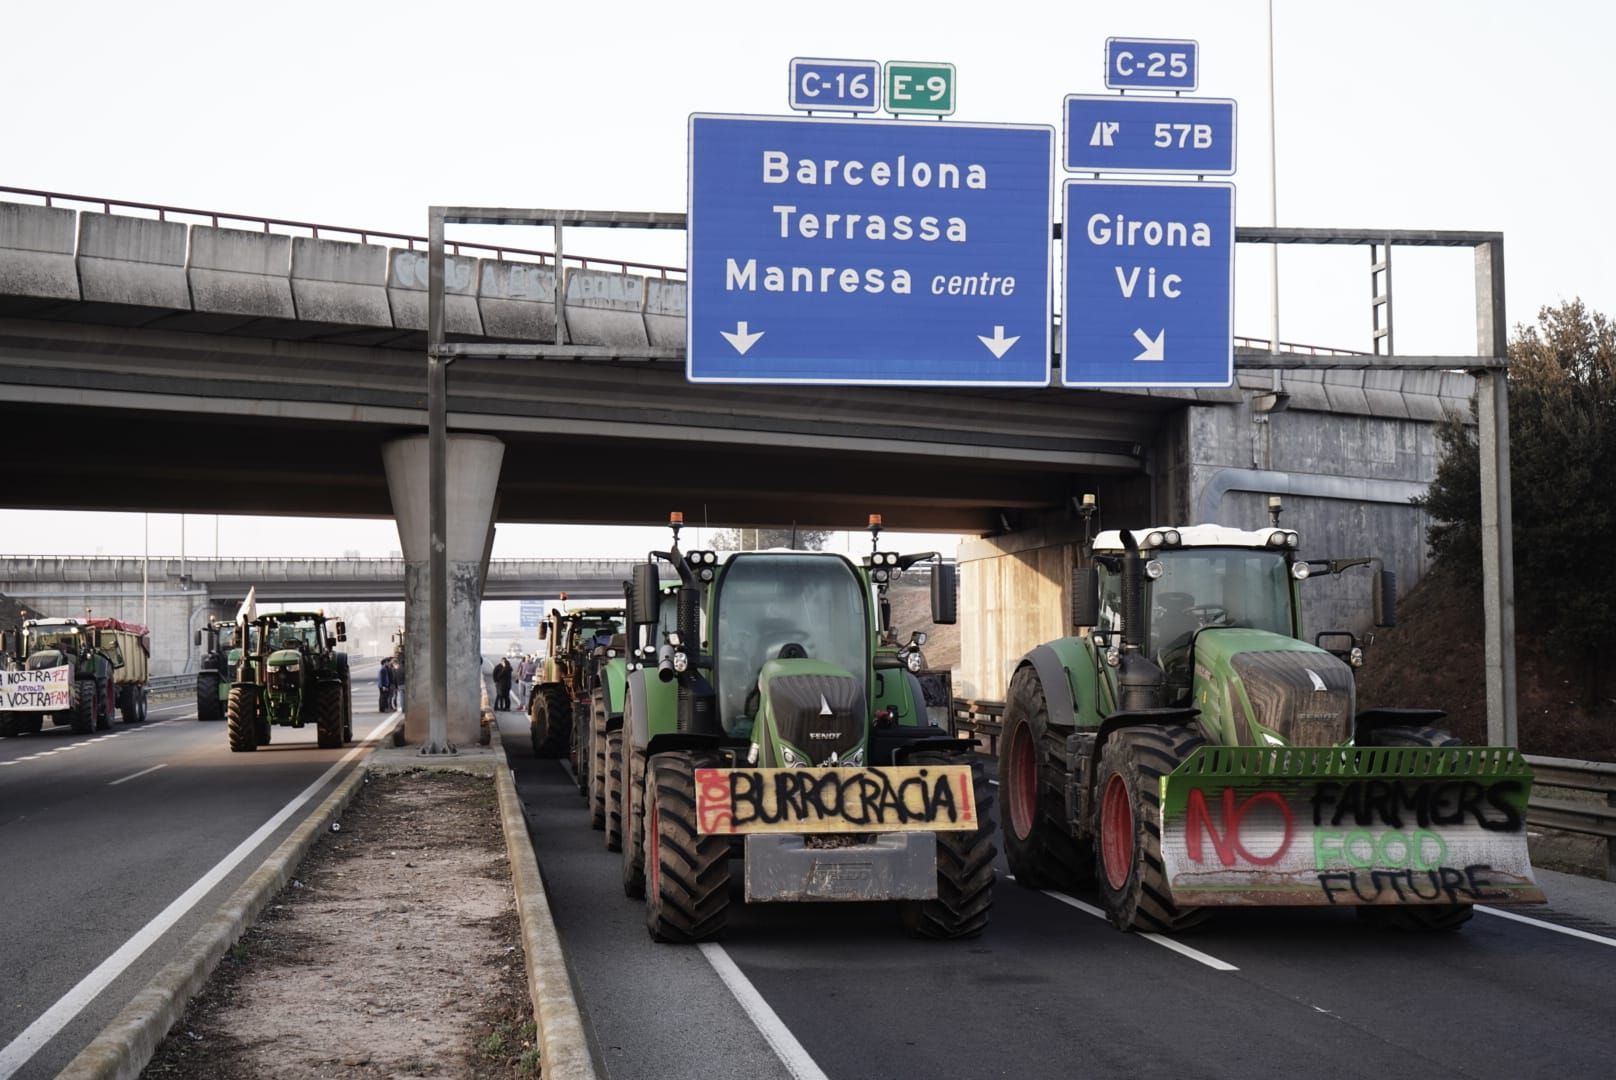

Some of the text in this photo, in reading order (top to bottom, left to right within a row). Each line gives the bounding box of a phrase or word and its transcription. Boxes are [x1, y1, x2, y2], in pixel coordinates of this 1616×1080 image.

[1116, 52, 1188, 78] C-25
[802, 72, 870, 98] C-16
[892, 75, 946, 101] E-9
[1154, 123, 1212, 149] 57B
[763, 151, 987, 189] Barcelona
[773, 205, 967, 242] Terrassa
[1087, 213, 1211, 247] Girona
[726, 258, 1015, 296] Manresa centre
[1115, 266, 1182, 298] Vic
[8, 671, 51, 685] NOSTRA
[7, 691, 51, 707] VOSTRA
[809, 732, 842, 740] FENDT
[1185, 780, 1525, 867] NO FARMERS
[1312, 829, 1450, 871] FOOD
[1317, 864, 1502, 905] FUTURE
